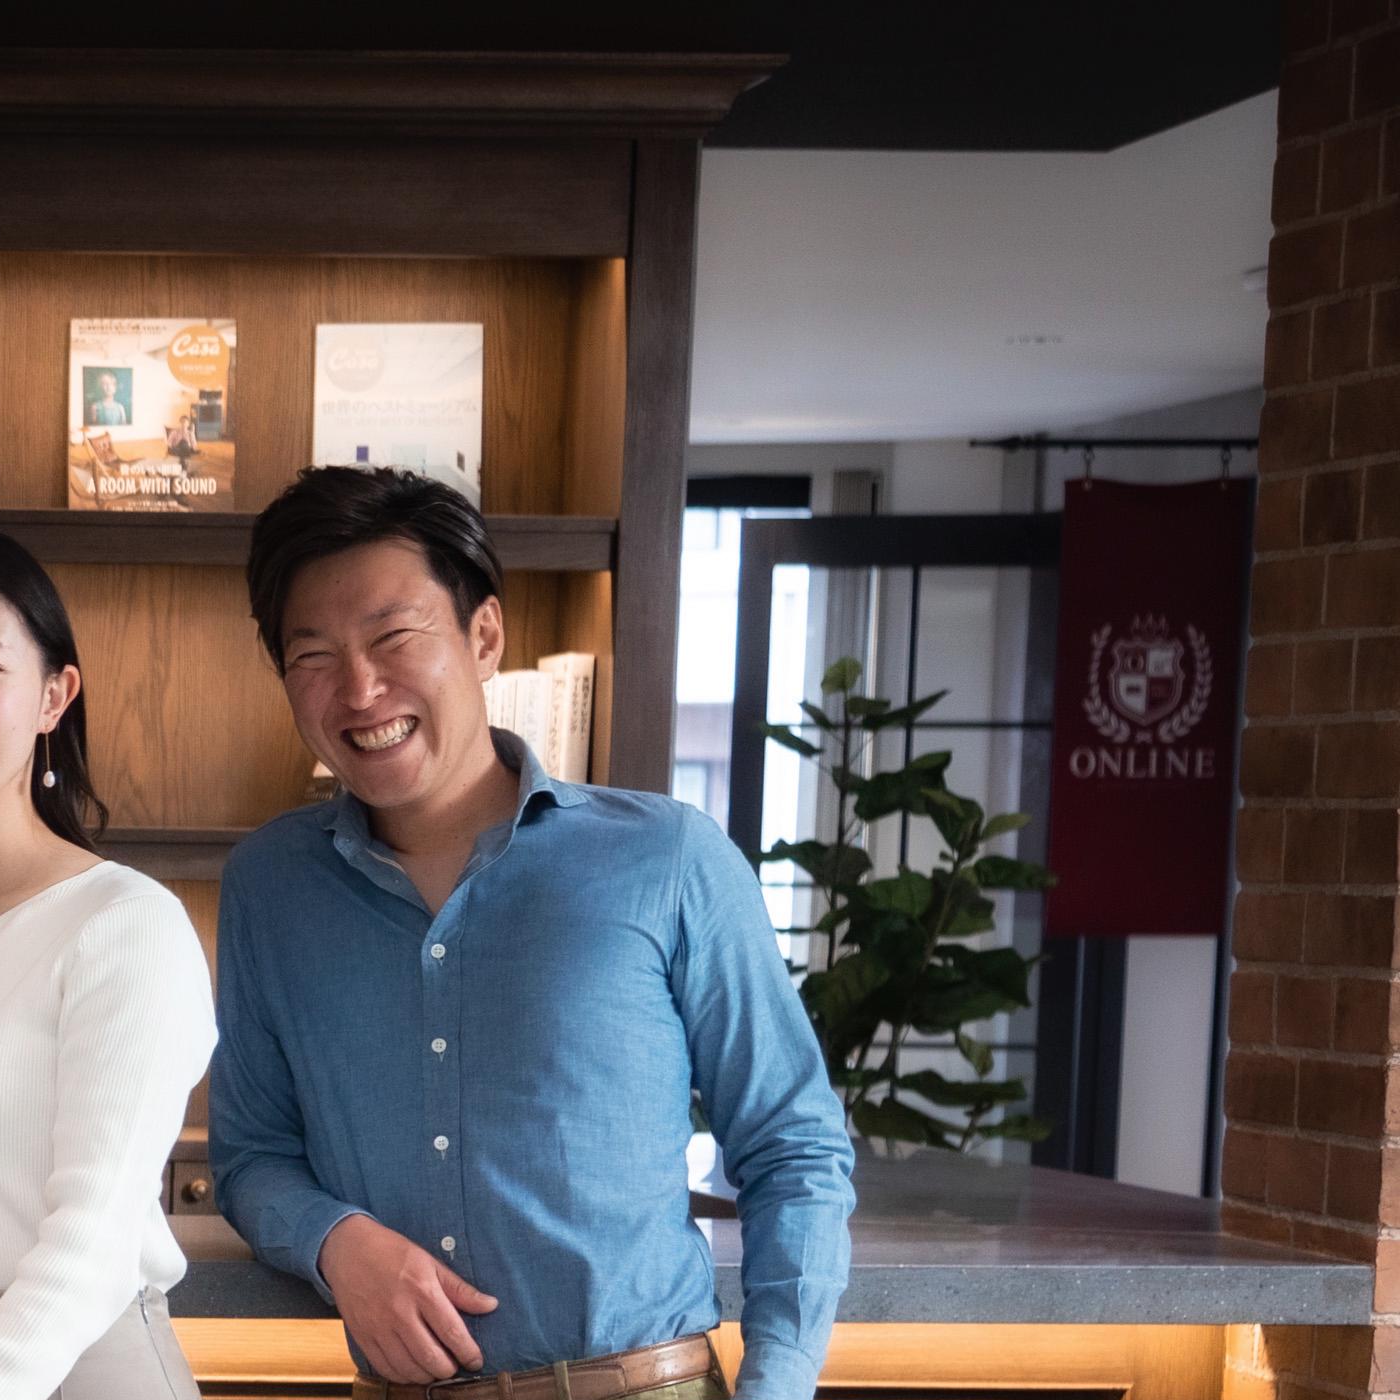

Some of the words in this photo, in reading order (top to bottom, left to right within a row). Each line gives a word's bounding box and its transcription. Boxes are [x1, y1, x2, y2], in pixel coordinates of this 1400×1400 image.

[171, 334, 221, 358] Casa
[87, 478, 95, 494] A
[99, 478, 137, 495] ROOM
[139, 478, 171, 495] WITH
[175, 478, 217, 495] SOUND
[1069, 747, 1216, 779] ONLINE
